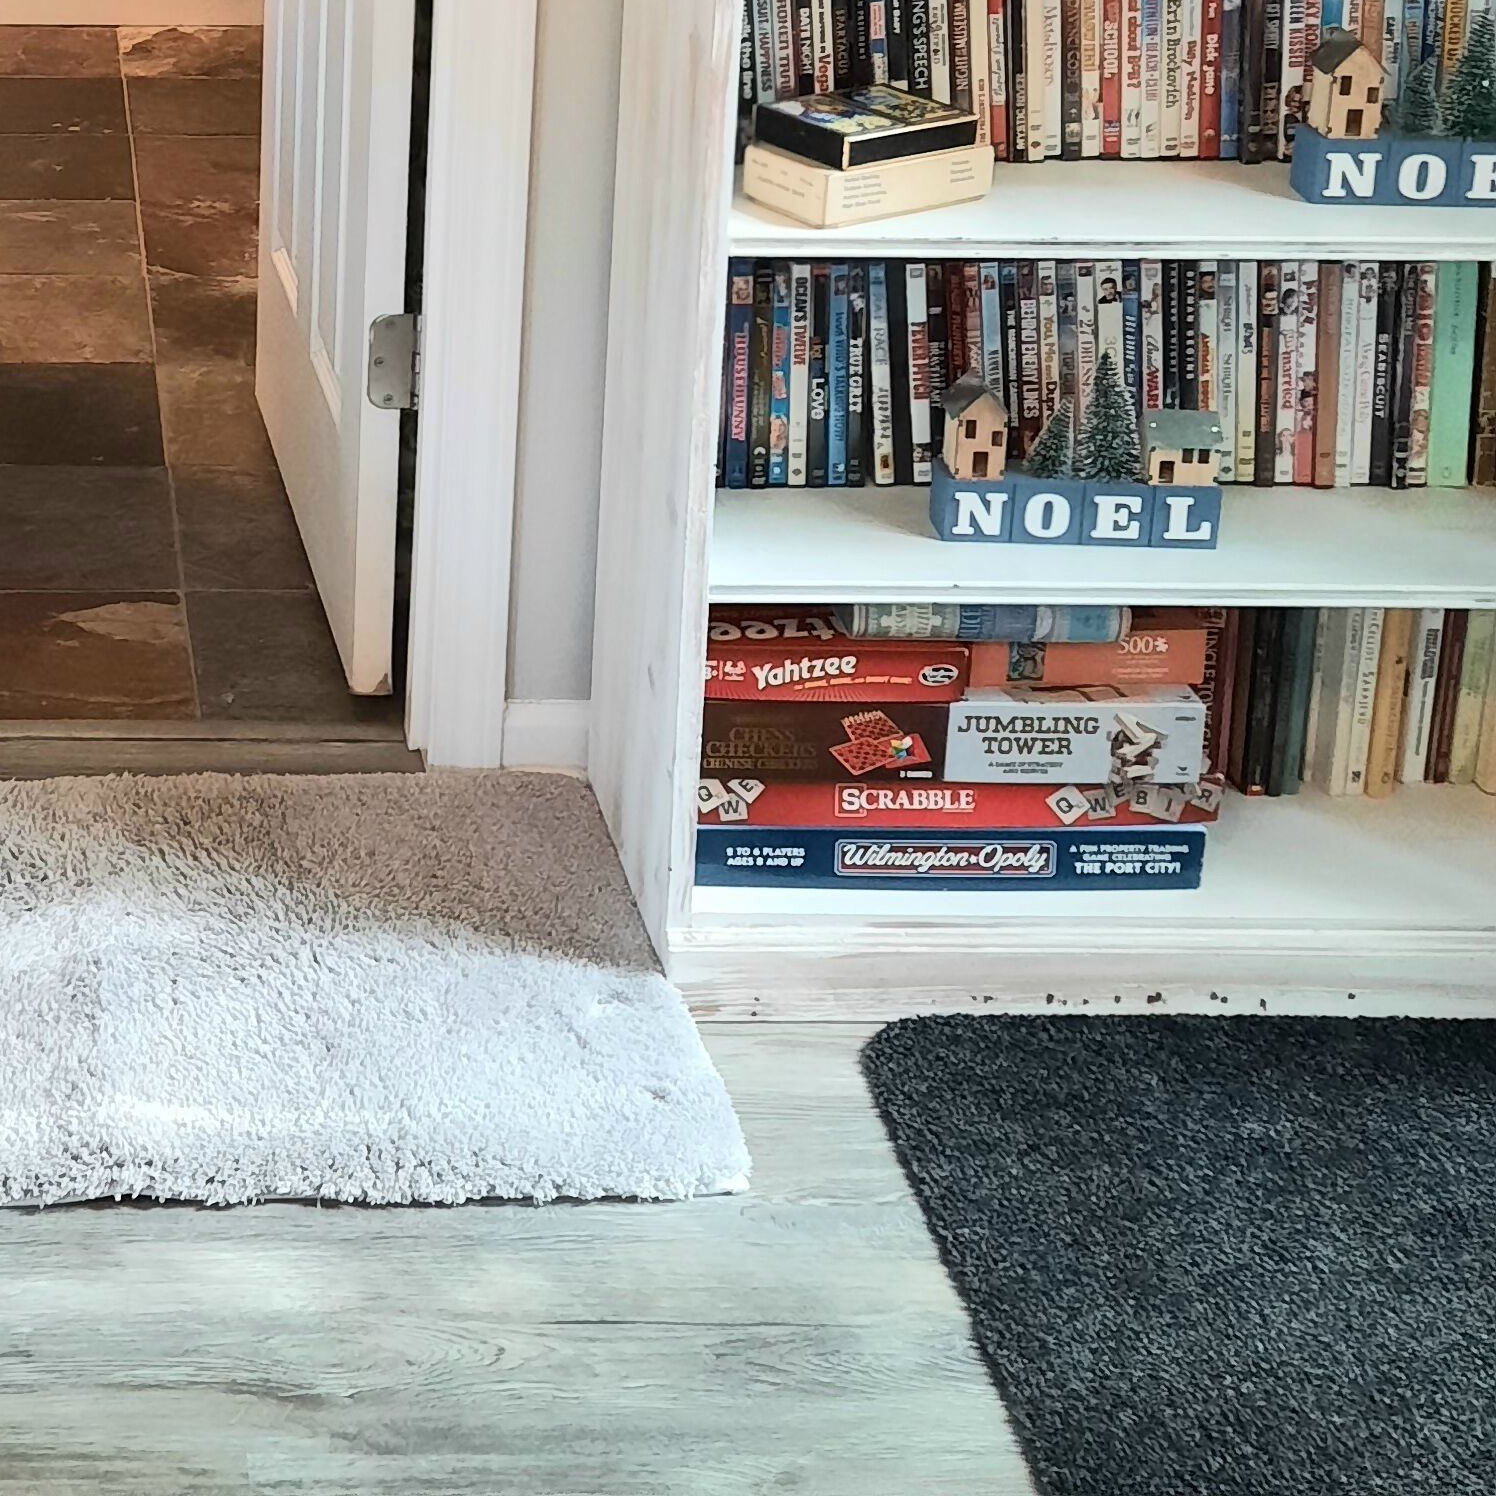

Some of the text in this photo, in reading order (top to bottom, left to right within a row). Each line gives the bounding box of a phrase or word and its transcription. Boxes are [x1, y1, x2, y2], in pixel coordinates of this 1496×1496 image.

[799, 7, 813, 75] DATE NIGHT
[835, 9, 849, 74] SPARTACUS
[952, 2, 969, 91] NIGHT MUSEUM
[1104, 20, 1119, 78] SCHOOL
[1205, 33, 1219, 62] Dick
[1288, 28, 1303, 69] KISSED
[816, 54, 832, 94] Vega
[912, 37, 928, 89] SPEECH
[1066, 50, 1080, 85] CODE
[1165, 38, 1182, 109] Brockovich
[793, 276, 809, 366] OCEAN'S TWELVE
[1079, 318, 1095, 336] 27
[1185, 270, 1195, 380] BATMAN BEGINS
[849, 336, 863, 414] TRUE GRIT
[911, 322, 930, 400] FEVER PITCH
[1020, 299, 1040, 419] BEHIND ENEMY LINES
[1374, 333, 1390, 419] SEABISCUIT
[1280, 350, 1295, 410] married
[951, 491, 1212, 541] NOEL
[709, 616, 836, 641] tzee
[1119, 635, 1154, 655] 500
[751, 655, 858, 691] Yahtzee
[729, 726, 795, 742] CHESS
[957, 715, 1101, 735] JUMBLING
[705, 741, 817, 757] CHECKERS
[982, 736, 1073, 756] TOWER
[721, 799, 740, 815] W
[841, 788, 976, 811] SCRABBLE
[1056, 796, 1074, 815] Q
[1090, 797, 1109, 813] W
[726, 857, 755, 866] AGES
[766, 857, 789, 867] AND
[790, 857, 805, 867] UP
[735, 847, 751, 856] TO
[762, 847, 806, 857] PLAYERS
[1074, 861, 1182, 874] THE PORT CITY!
